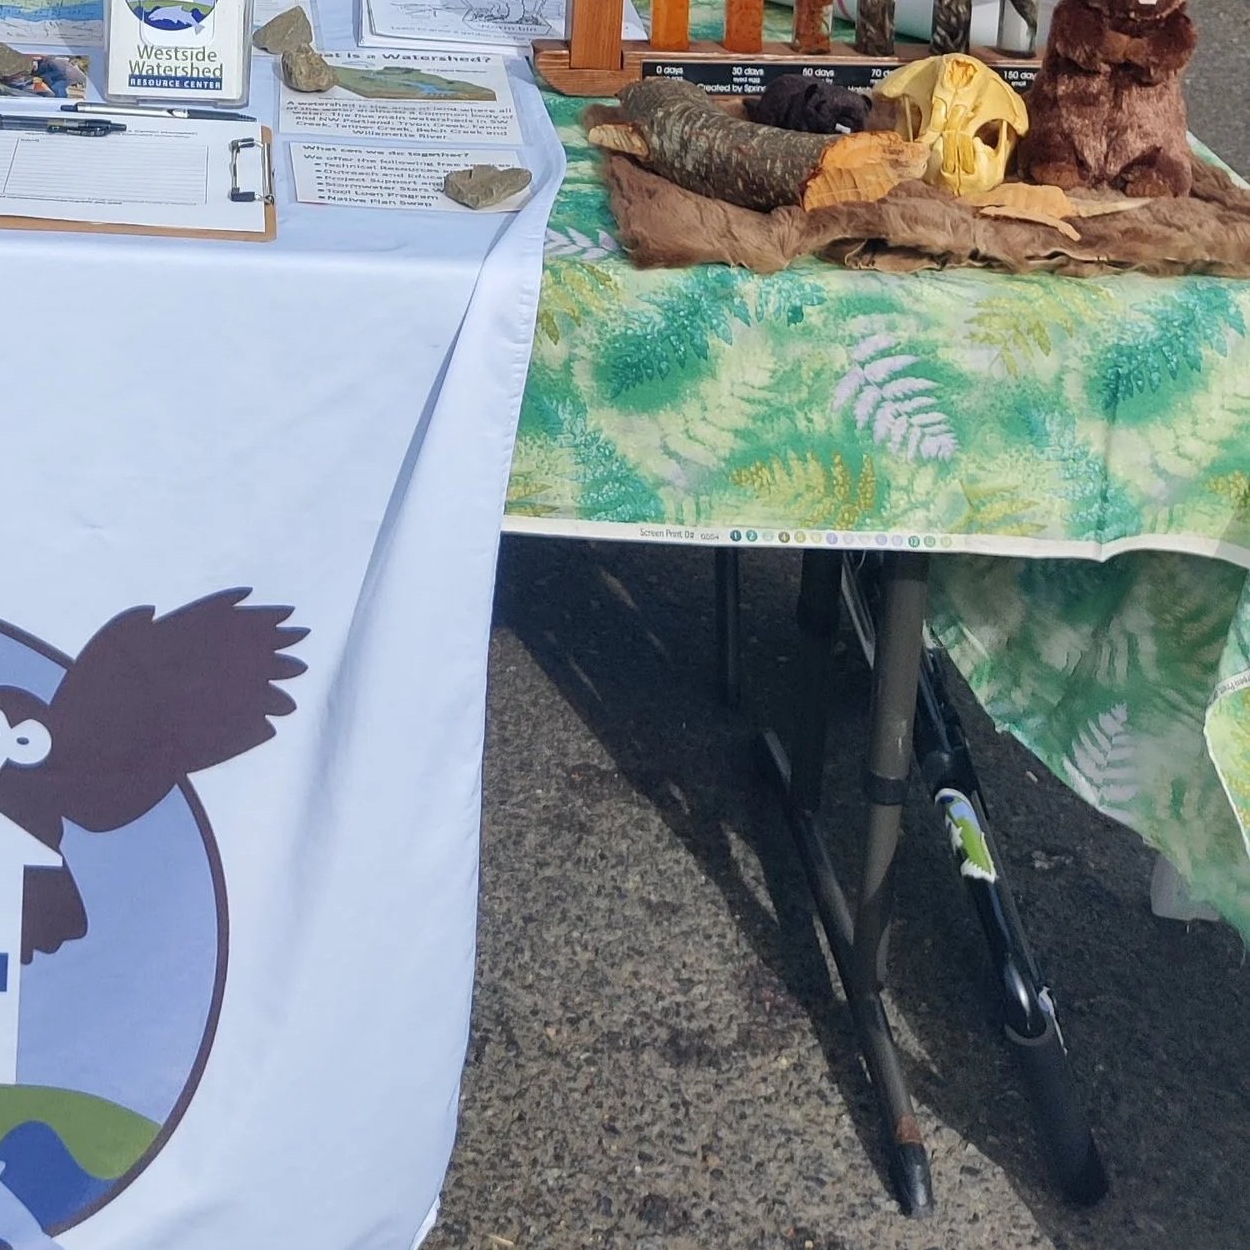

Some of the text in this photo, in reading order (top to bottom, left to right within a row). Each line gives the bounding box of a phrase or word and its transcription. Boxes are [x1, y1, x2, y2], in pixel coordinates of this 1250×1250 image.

[136, 44, 217, 62] Westside
[382, 54, 491, 62] Watershed?
[129, 60, 223, 77] Watershed
[656, 65, 684, 76] 0 days
[732, 66, 765, 76] 30 days
[815, 68, 835, 77] days
[871, 69, 882, 78] 70
[130, 78, 221, 89] RESOURCE CENTER
[697, 83, 742, 93] Created by
